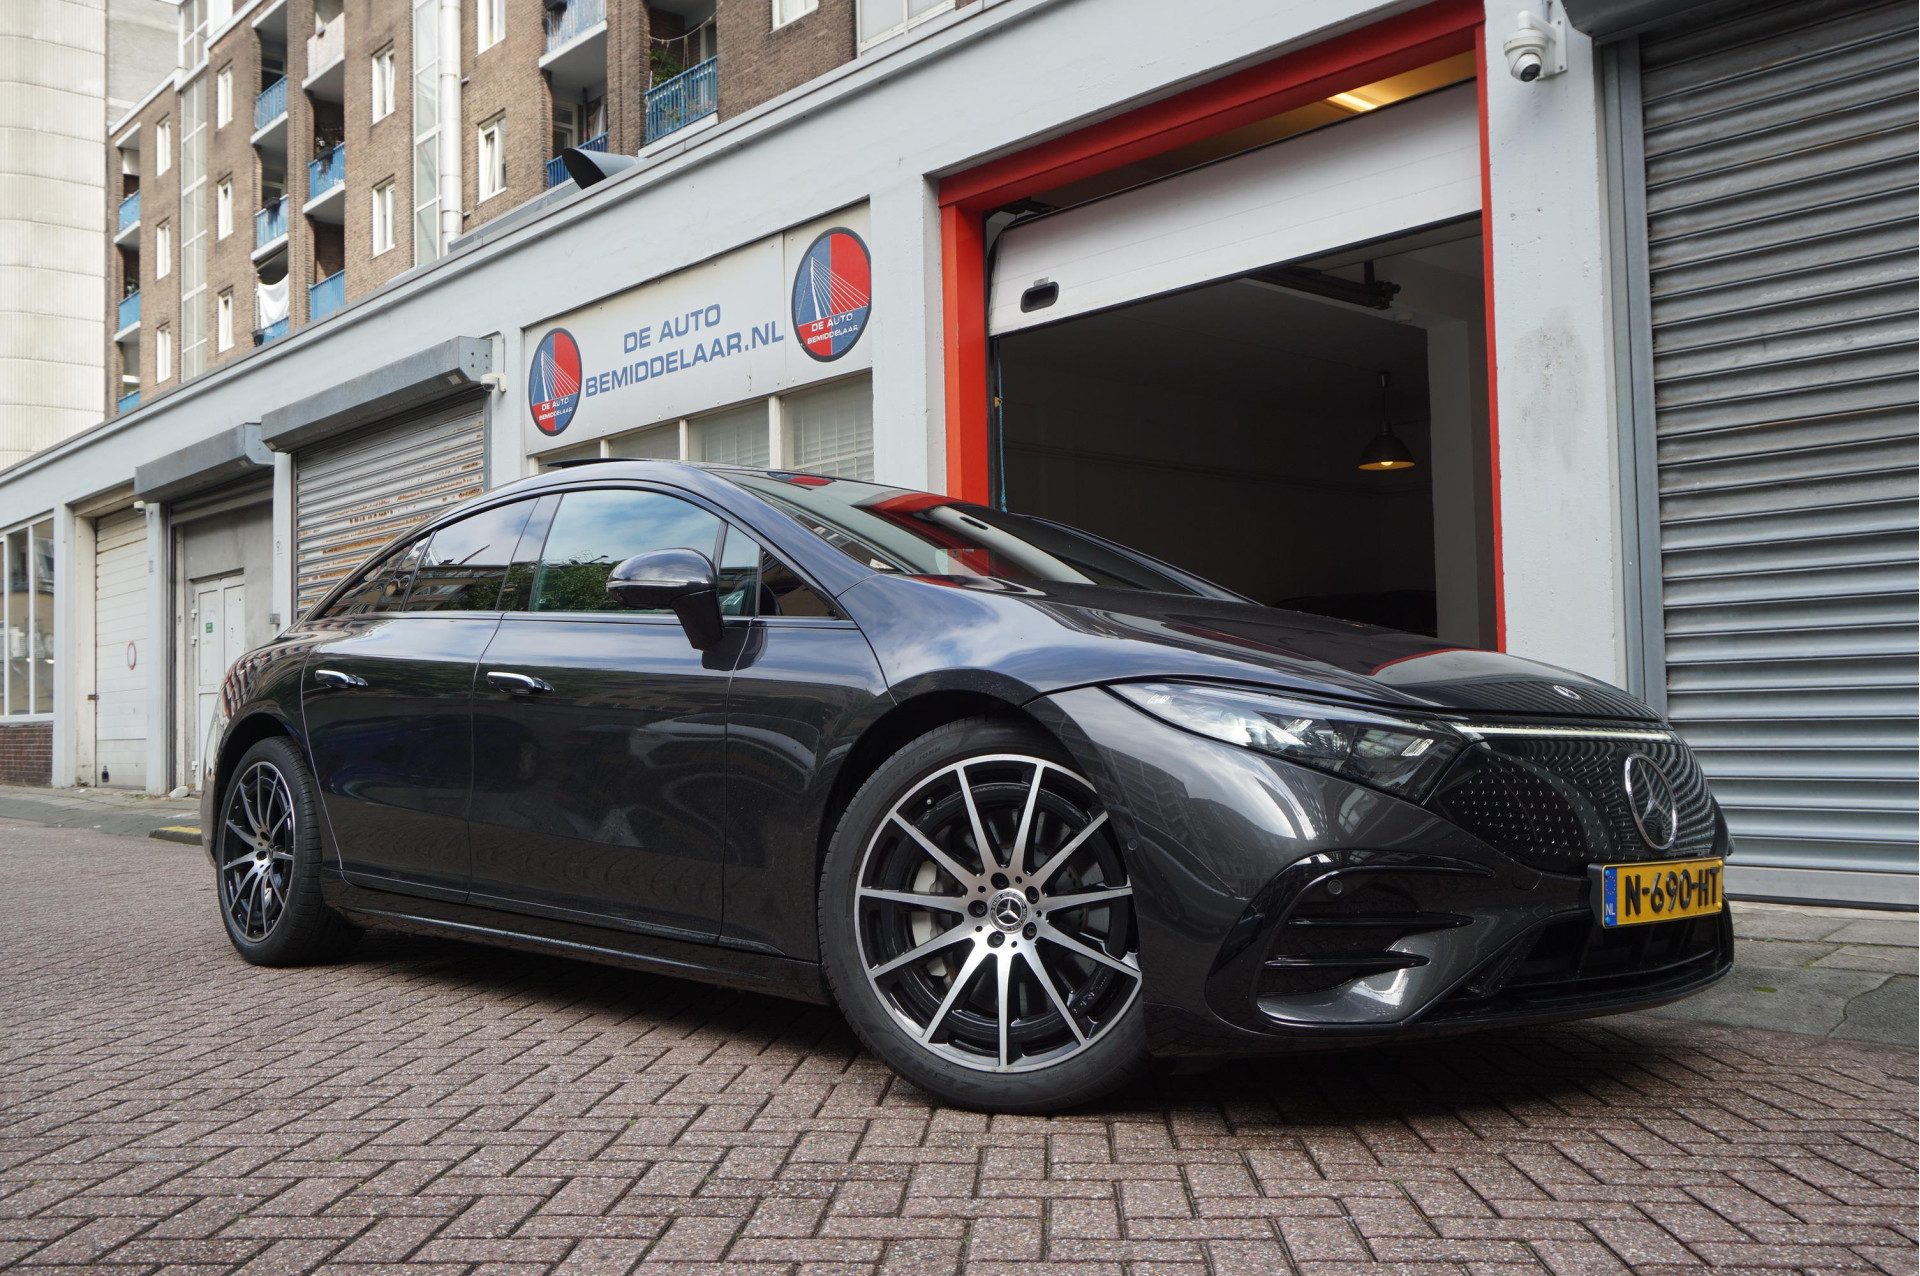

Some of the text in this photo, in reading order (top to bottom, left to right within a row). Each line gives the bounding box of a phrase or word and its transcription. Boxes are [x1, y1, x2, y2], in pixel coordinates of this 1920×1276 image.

[624, 303, 721, 354] DE AUTO
[811, 312, 853, 332] DE AUTO
[807, 324, 858, 344] BEMIDDELAAR
[585, 320, 785, 398] BEMIDDELAAR.NL
[541, 397, 569, 411] DE AUTO
[1625, 867, 1720, 917] N-690-HT
[1605, 903, 1616, 916] NL
